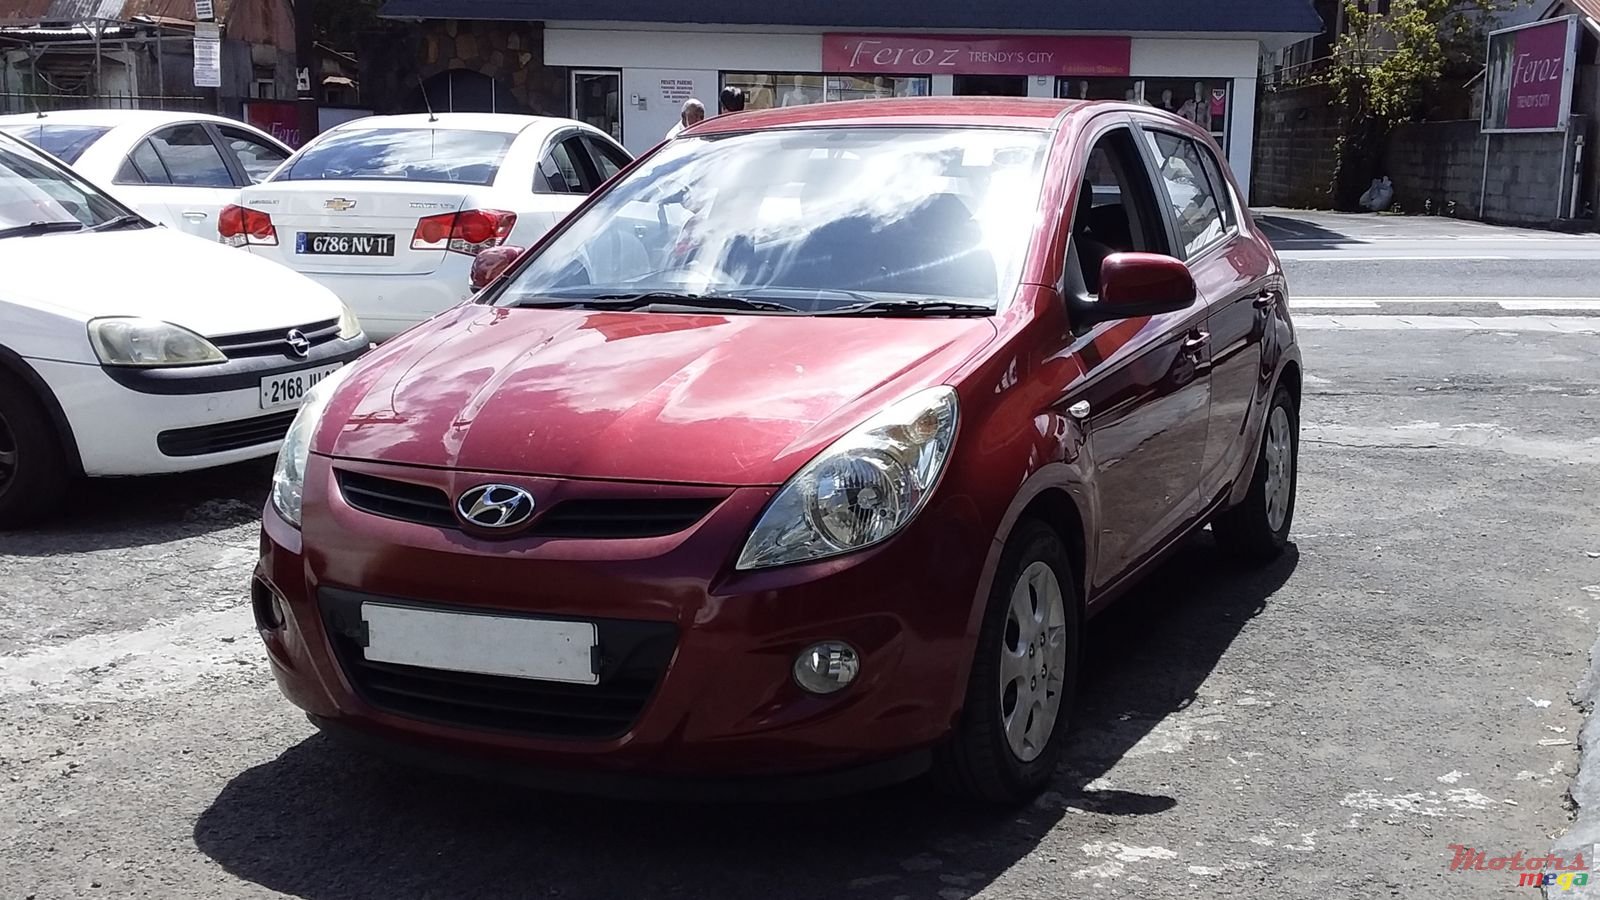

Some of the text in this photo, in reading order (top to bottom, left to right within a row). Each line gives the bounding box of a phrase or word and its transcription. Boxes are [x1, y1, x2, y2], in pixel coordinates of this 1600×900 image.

[845, 40, 1055, 67] Feroz TRENDY'S CITY
[1512, 53, 1561, 88] Feroz
[270, 122, 300, 145] Fero
[313, 236, 388, 254] 6786 NV 11
[271, 376, 303, 403] 2168
